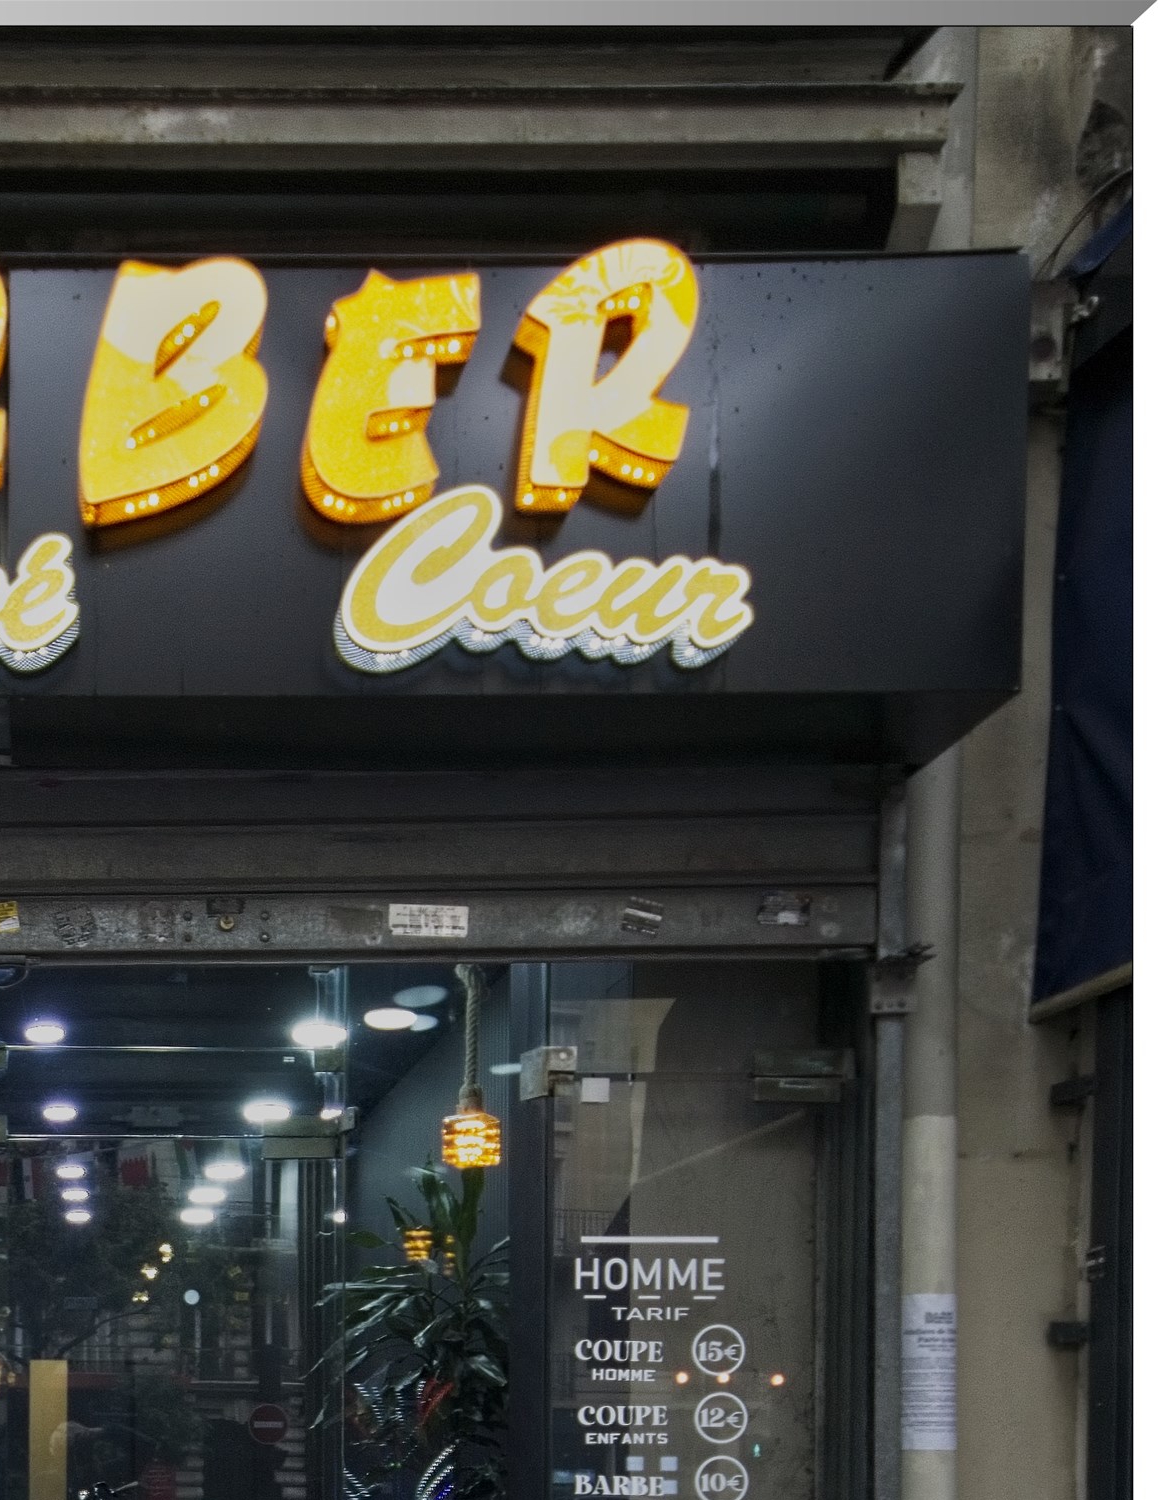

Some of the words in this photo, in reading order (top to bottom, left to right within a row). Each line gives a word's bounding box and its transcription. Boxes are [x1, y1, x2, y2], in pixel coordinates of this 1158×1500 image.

[334, 483, 754, 674] Coeur
[574, 1257, 725, 1292] HOMME
[611, 1306, 690, 1321] TARIF
[574, 1339, 664, 1362] COUPE
[697, 1341, 741, 1361] 15€
[591, 1368, 656, 1381] HOMME
[577, 1405, 668, 1426] COUPE
[701, 1408, 743, 1428] 12€
[585, 1432, 669, 1445] ENFANTS
[574, 1474, 665, 1496] BARBE
[700, 1473, 743, 1492] 10€
